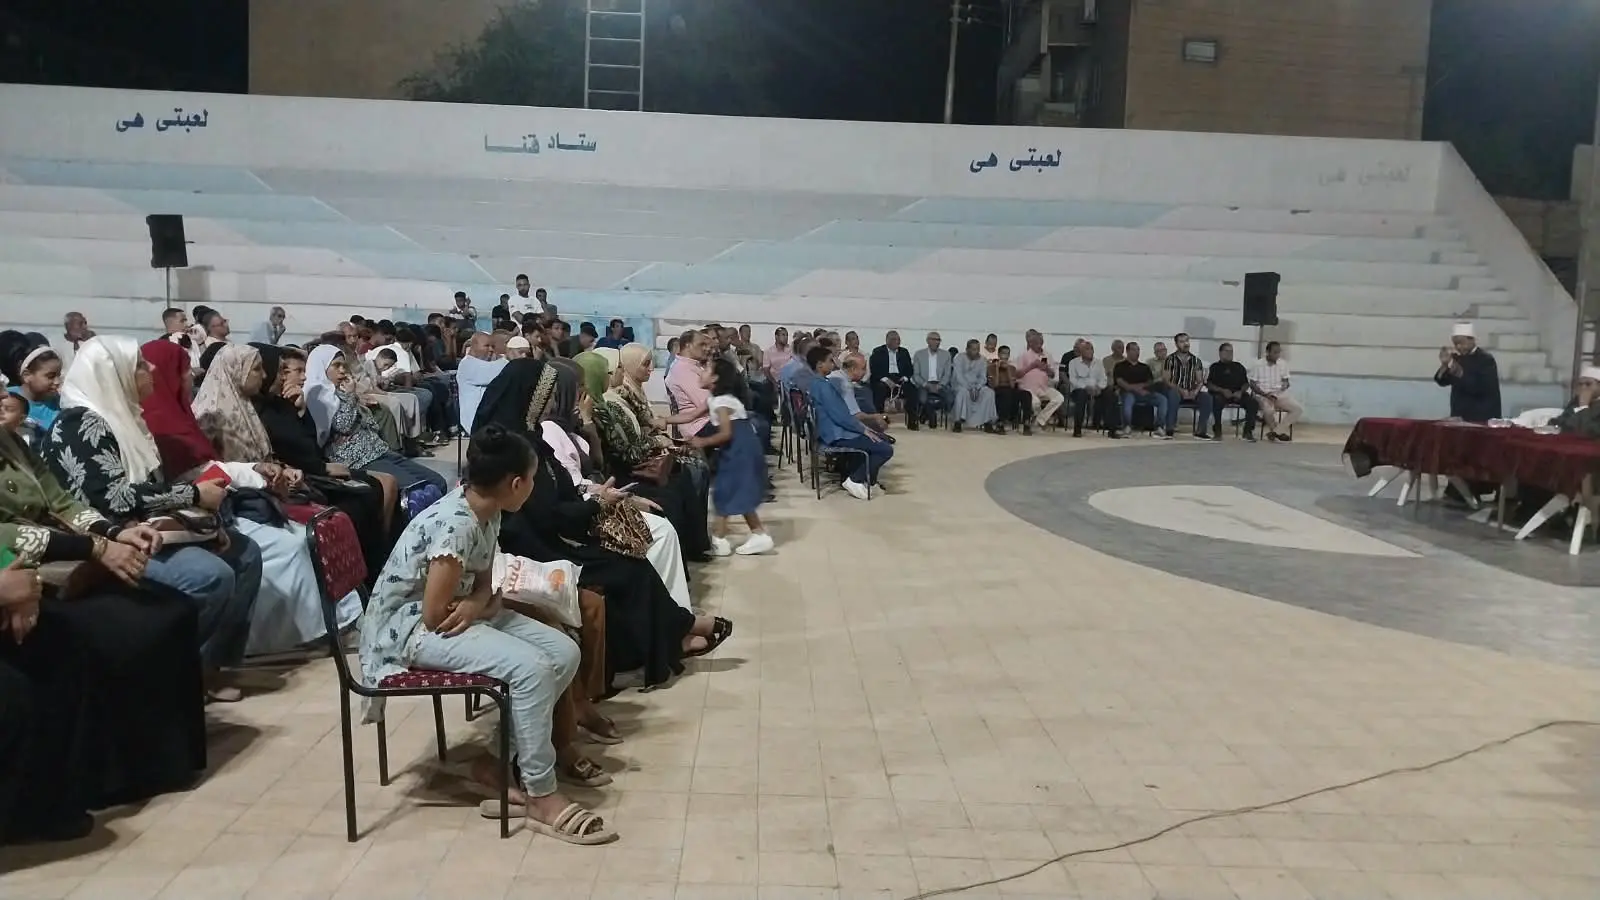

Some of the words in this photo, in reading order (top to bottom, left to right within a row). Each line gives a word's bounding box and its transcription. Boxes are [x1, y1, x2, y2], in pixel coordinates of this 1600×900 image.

[116, 112, 144, 132] هى
[156, 108, 208, 133] لعبتى
[485, 133, 540, 153] قنا
[548, 132, 597, 151] ستاد
[970, 152, 998, 173] هى
[1009, 148, 1062, 173] لعبتى
